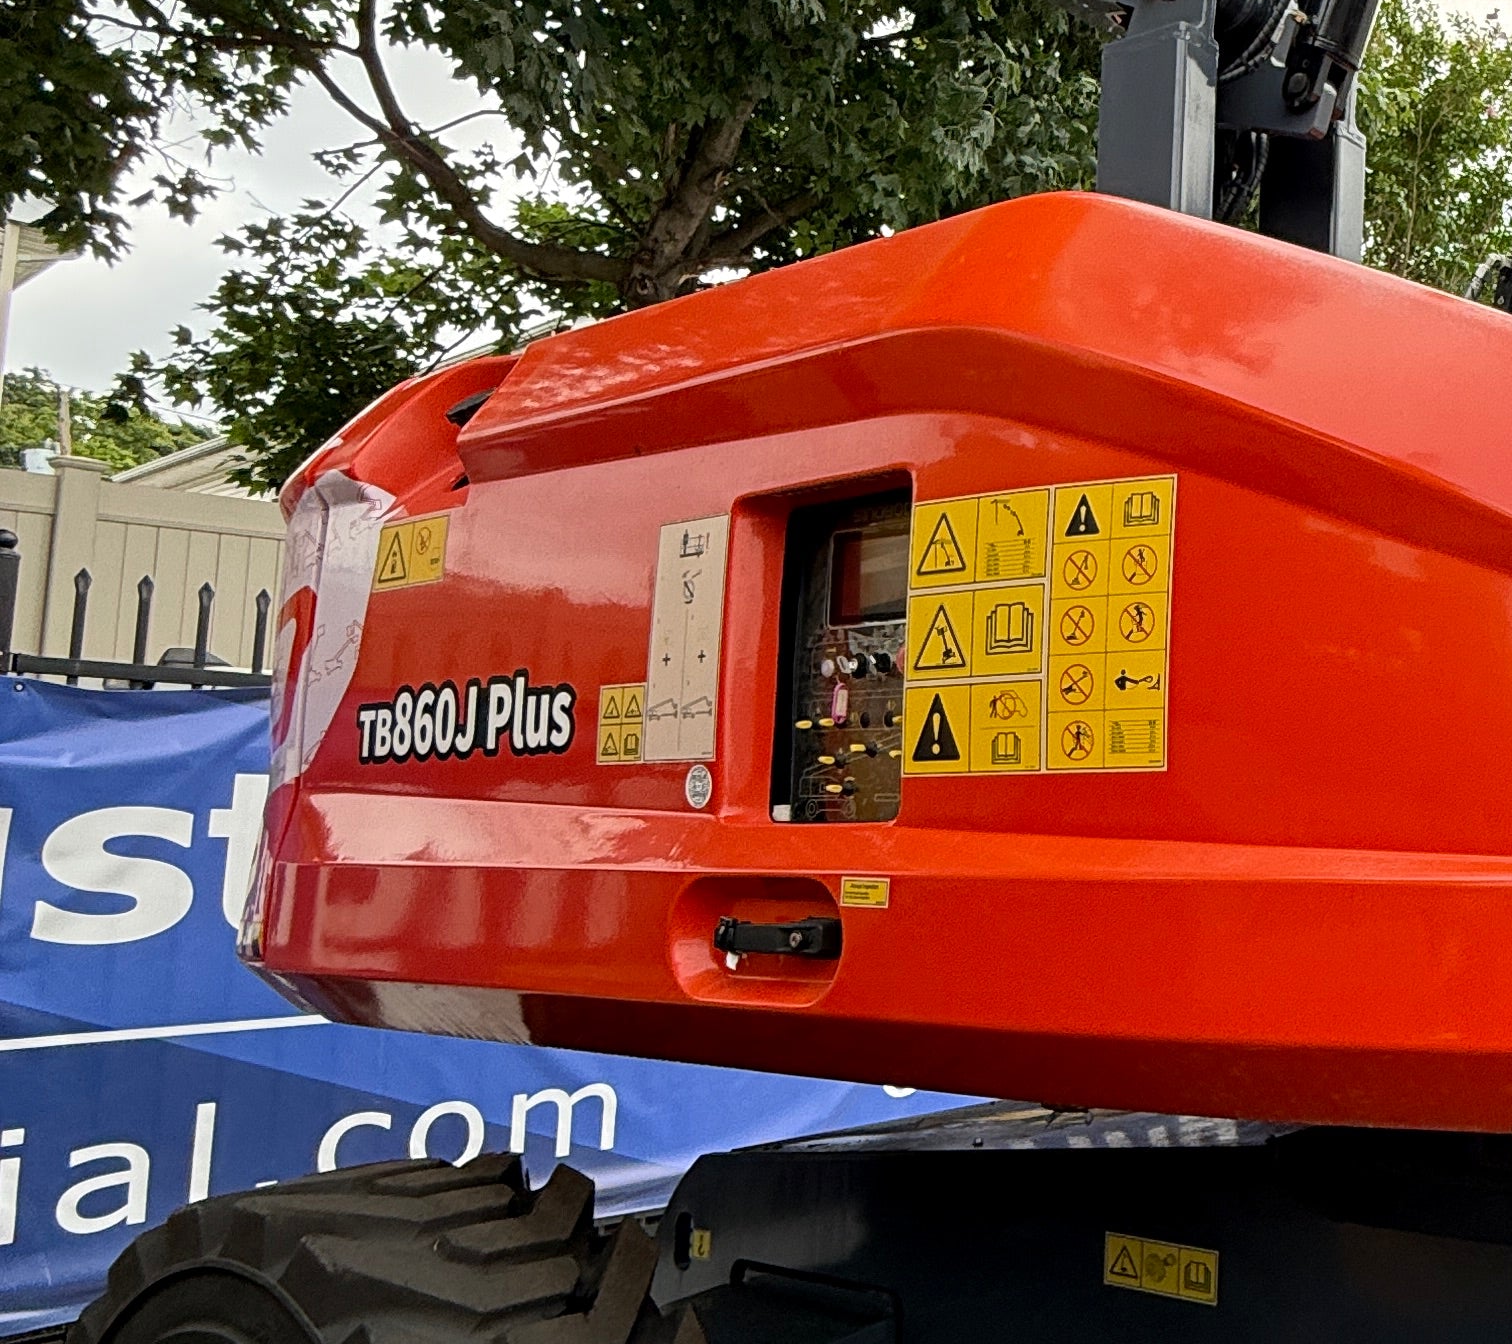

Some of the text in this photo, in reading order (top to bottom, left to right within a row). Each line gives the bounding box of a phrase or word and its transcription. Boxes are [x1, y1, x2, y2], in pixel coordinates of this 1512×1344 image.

[359, 676, 572, 758] TB860J Plus
[0, 773, 270, 945] st
